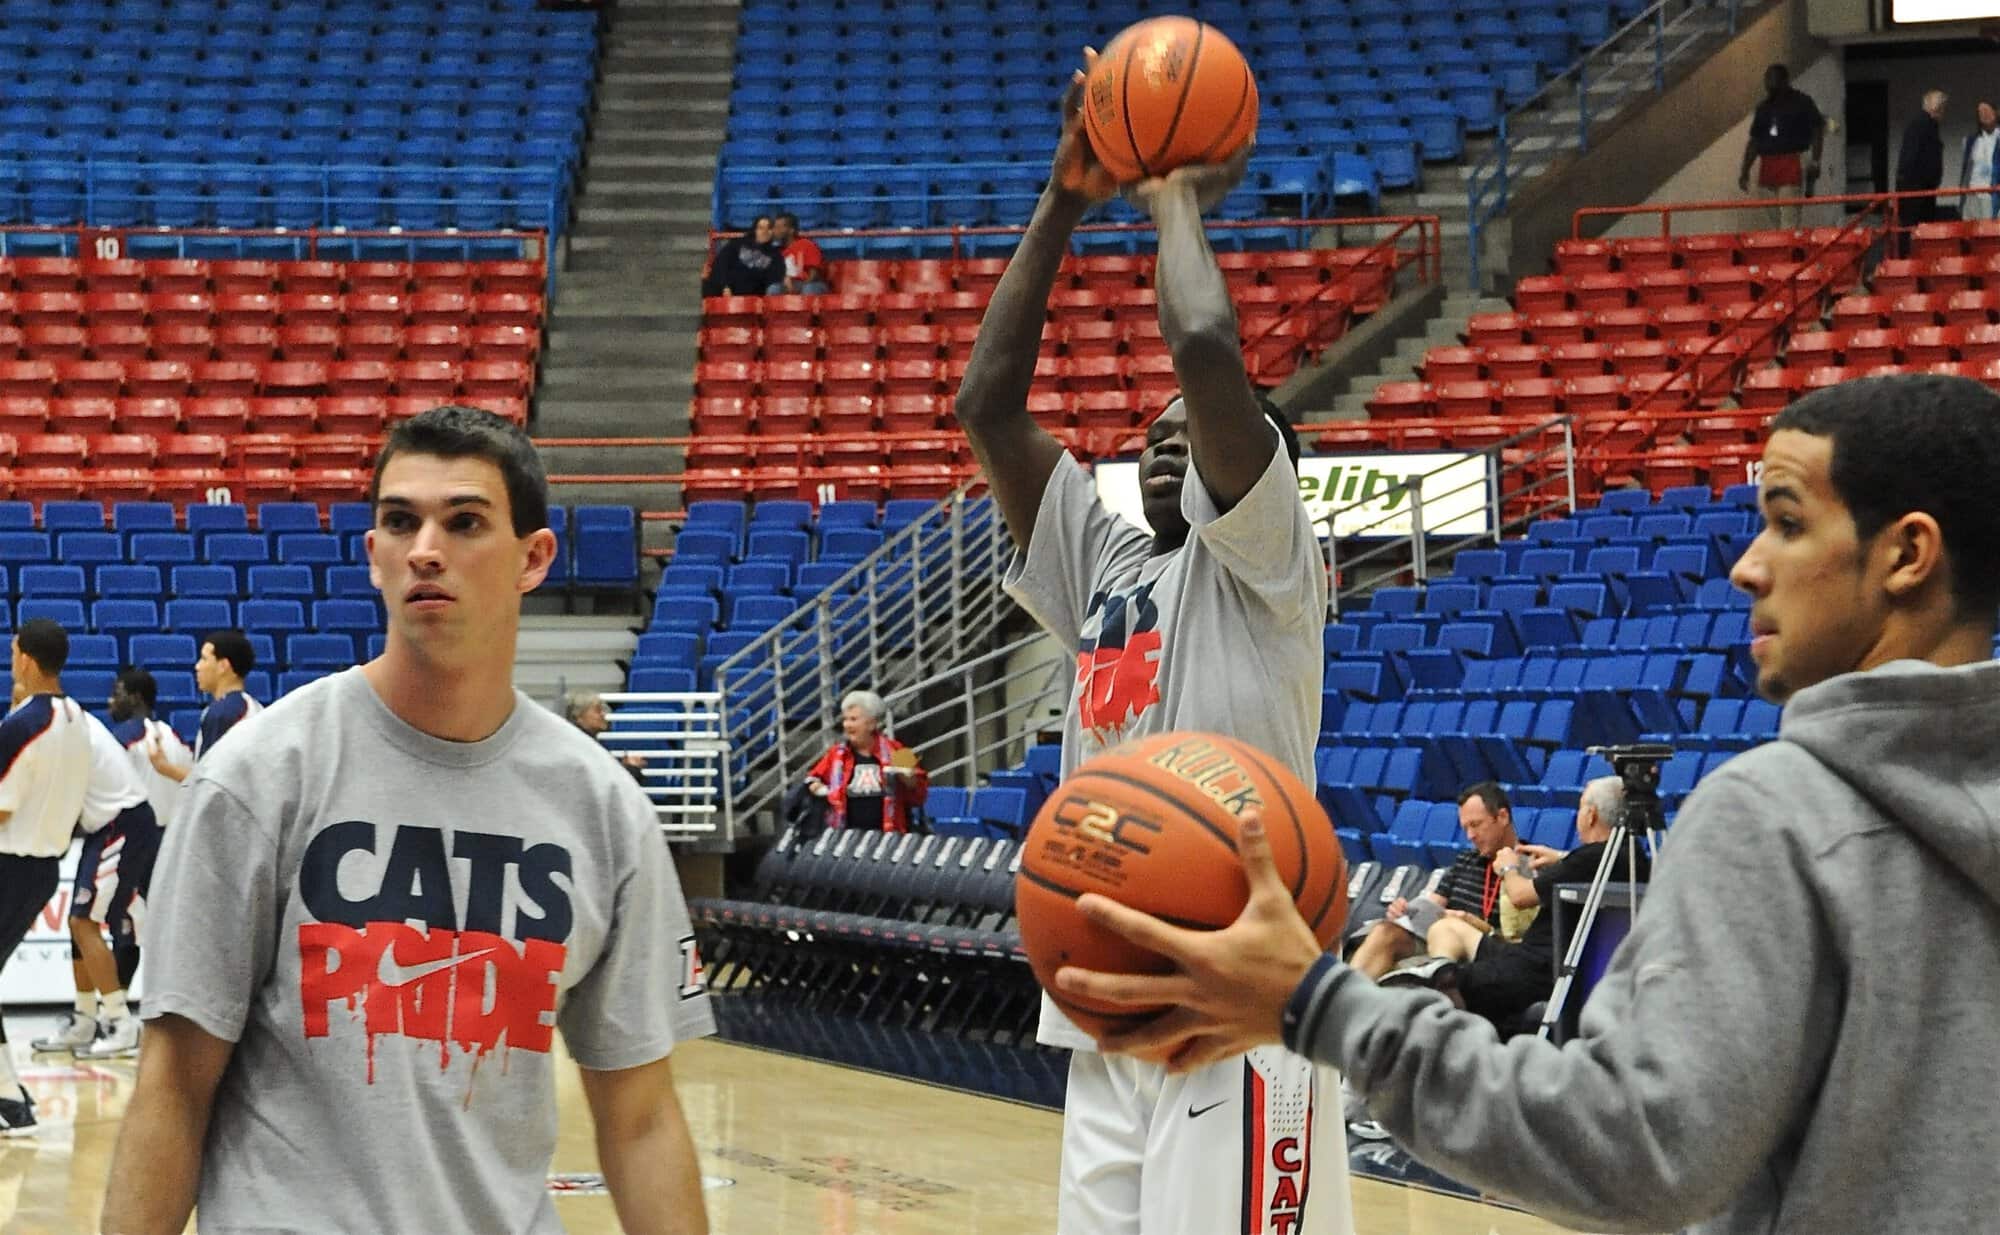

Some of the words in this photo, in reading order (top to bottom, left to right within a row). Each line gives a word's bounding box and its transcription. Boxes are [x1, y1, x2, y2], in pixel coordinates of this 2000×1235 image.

[95, 237, 119, 260] 10
[206, 487, 231, 507] 10
[817, 484, 836, 506] 11
[1150, 739, 1264, 816] ROCK
[300, 821, 574, 944] CATS
[298, 921, 568, 1056] PRIDE
